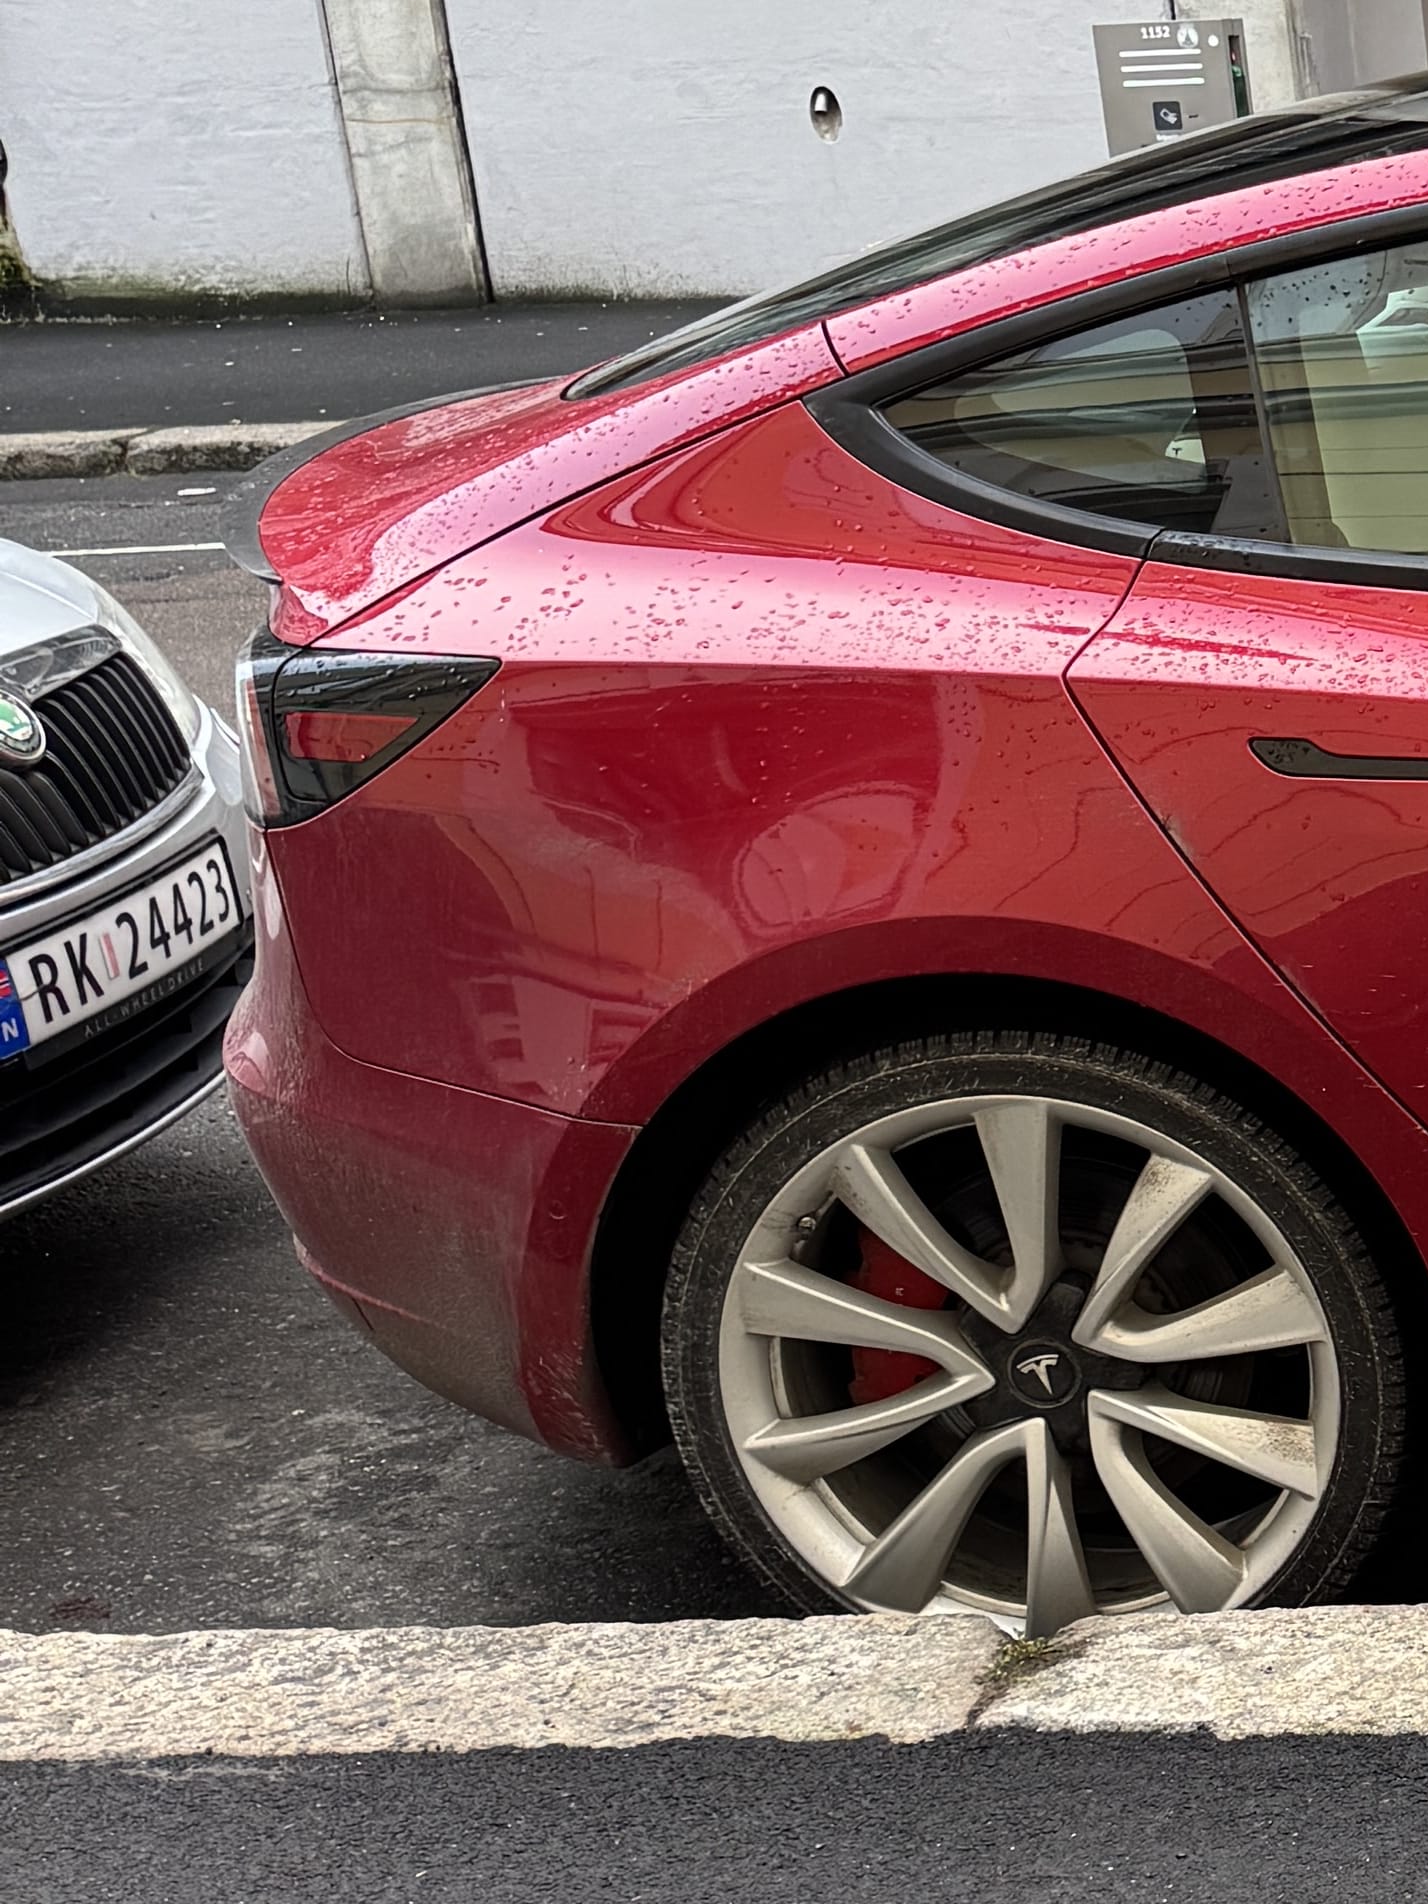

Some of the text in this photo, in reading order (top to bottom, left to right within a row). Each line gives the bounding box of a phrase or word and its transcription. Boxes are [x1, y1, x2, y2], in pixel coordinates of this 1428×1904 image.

[1140, 25, 1171, 40] 1152
[28, 858, 230, 1024] RK 24423
[1, 1017, 20, 1042] N
